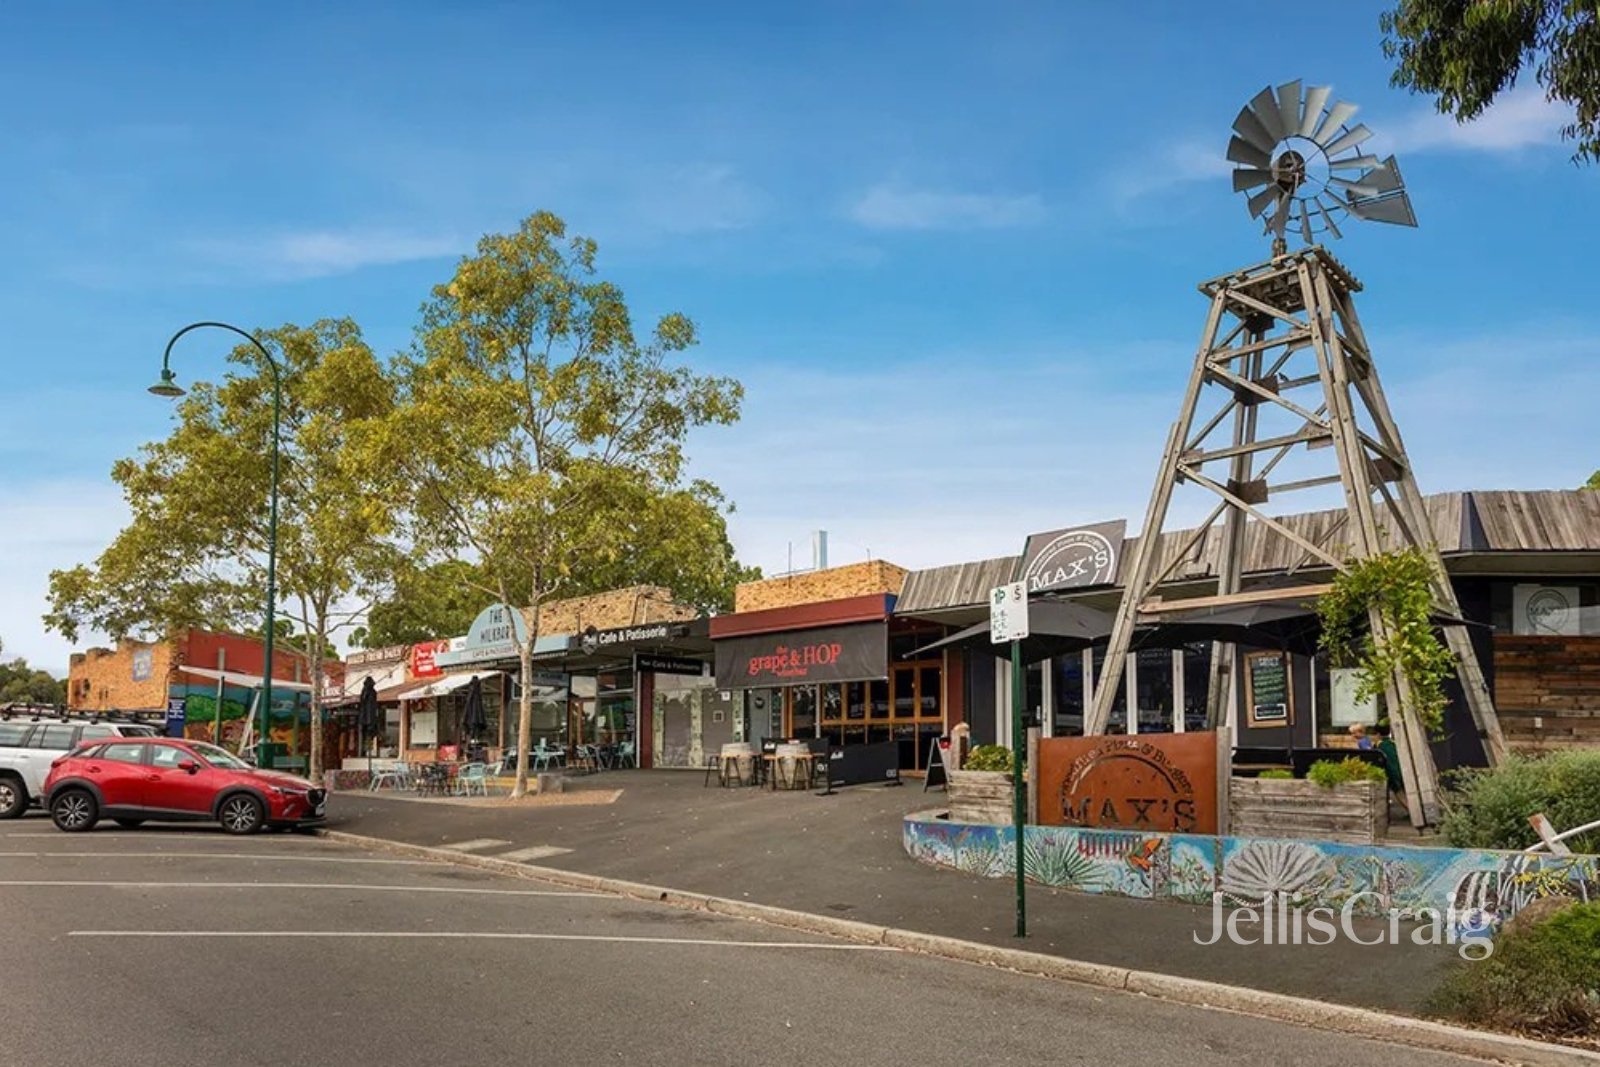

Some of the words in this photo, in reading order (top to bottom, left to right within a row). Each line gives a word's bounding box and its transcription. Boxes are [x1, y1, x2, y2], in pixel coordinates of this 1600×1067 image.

[1030, 550, 1109, 592] MAX'S
[489, 608, 503, 623] THE
[480, 625, 511, 643] MILKBAR
[600, 631, 618, 644] Cafe
[618, 629, 625, 642] &
[626, 625, 668, 641] Patisserie
[748, 654, 787, 676] grape
[789, 650, 801, 666] &
[803, 643, 842, 665] HOP
[1062, 796, 1197, 833] MAX'S
